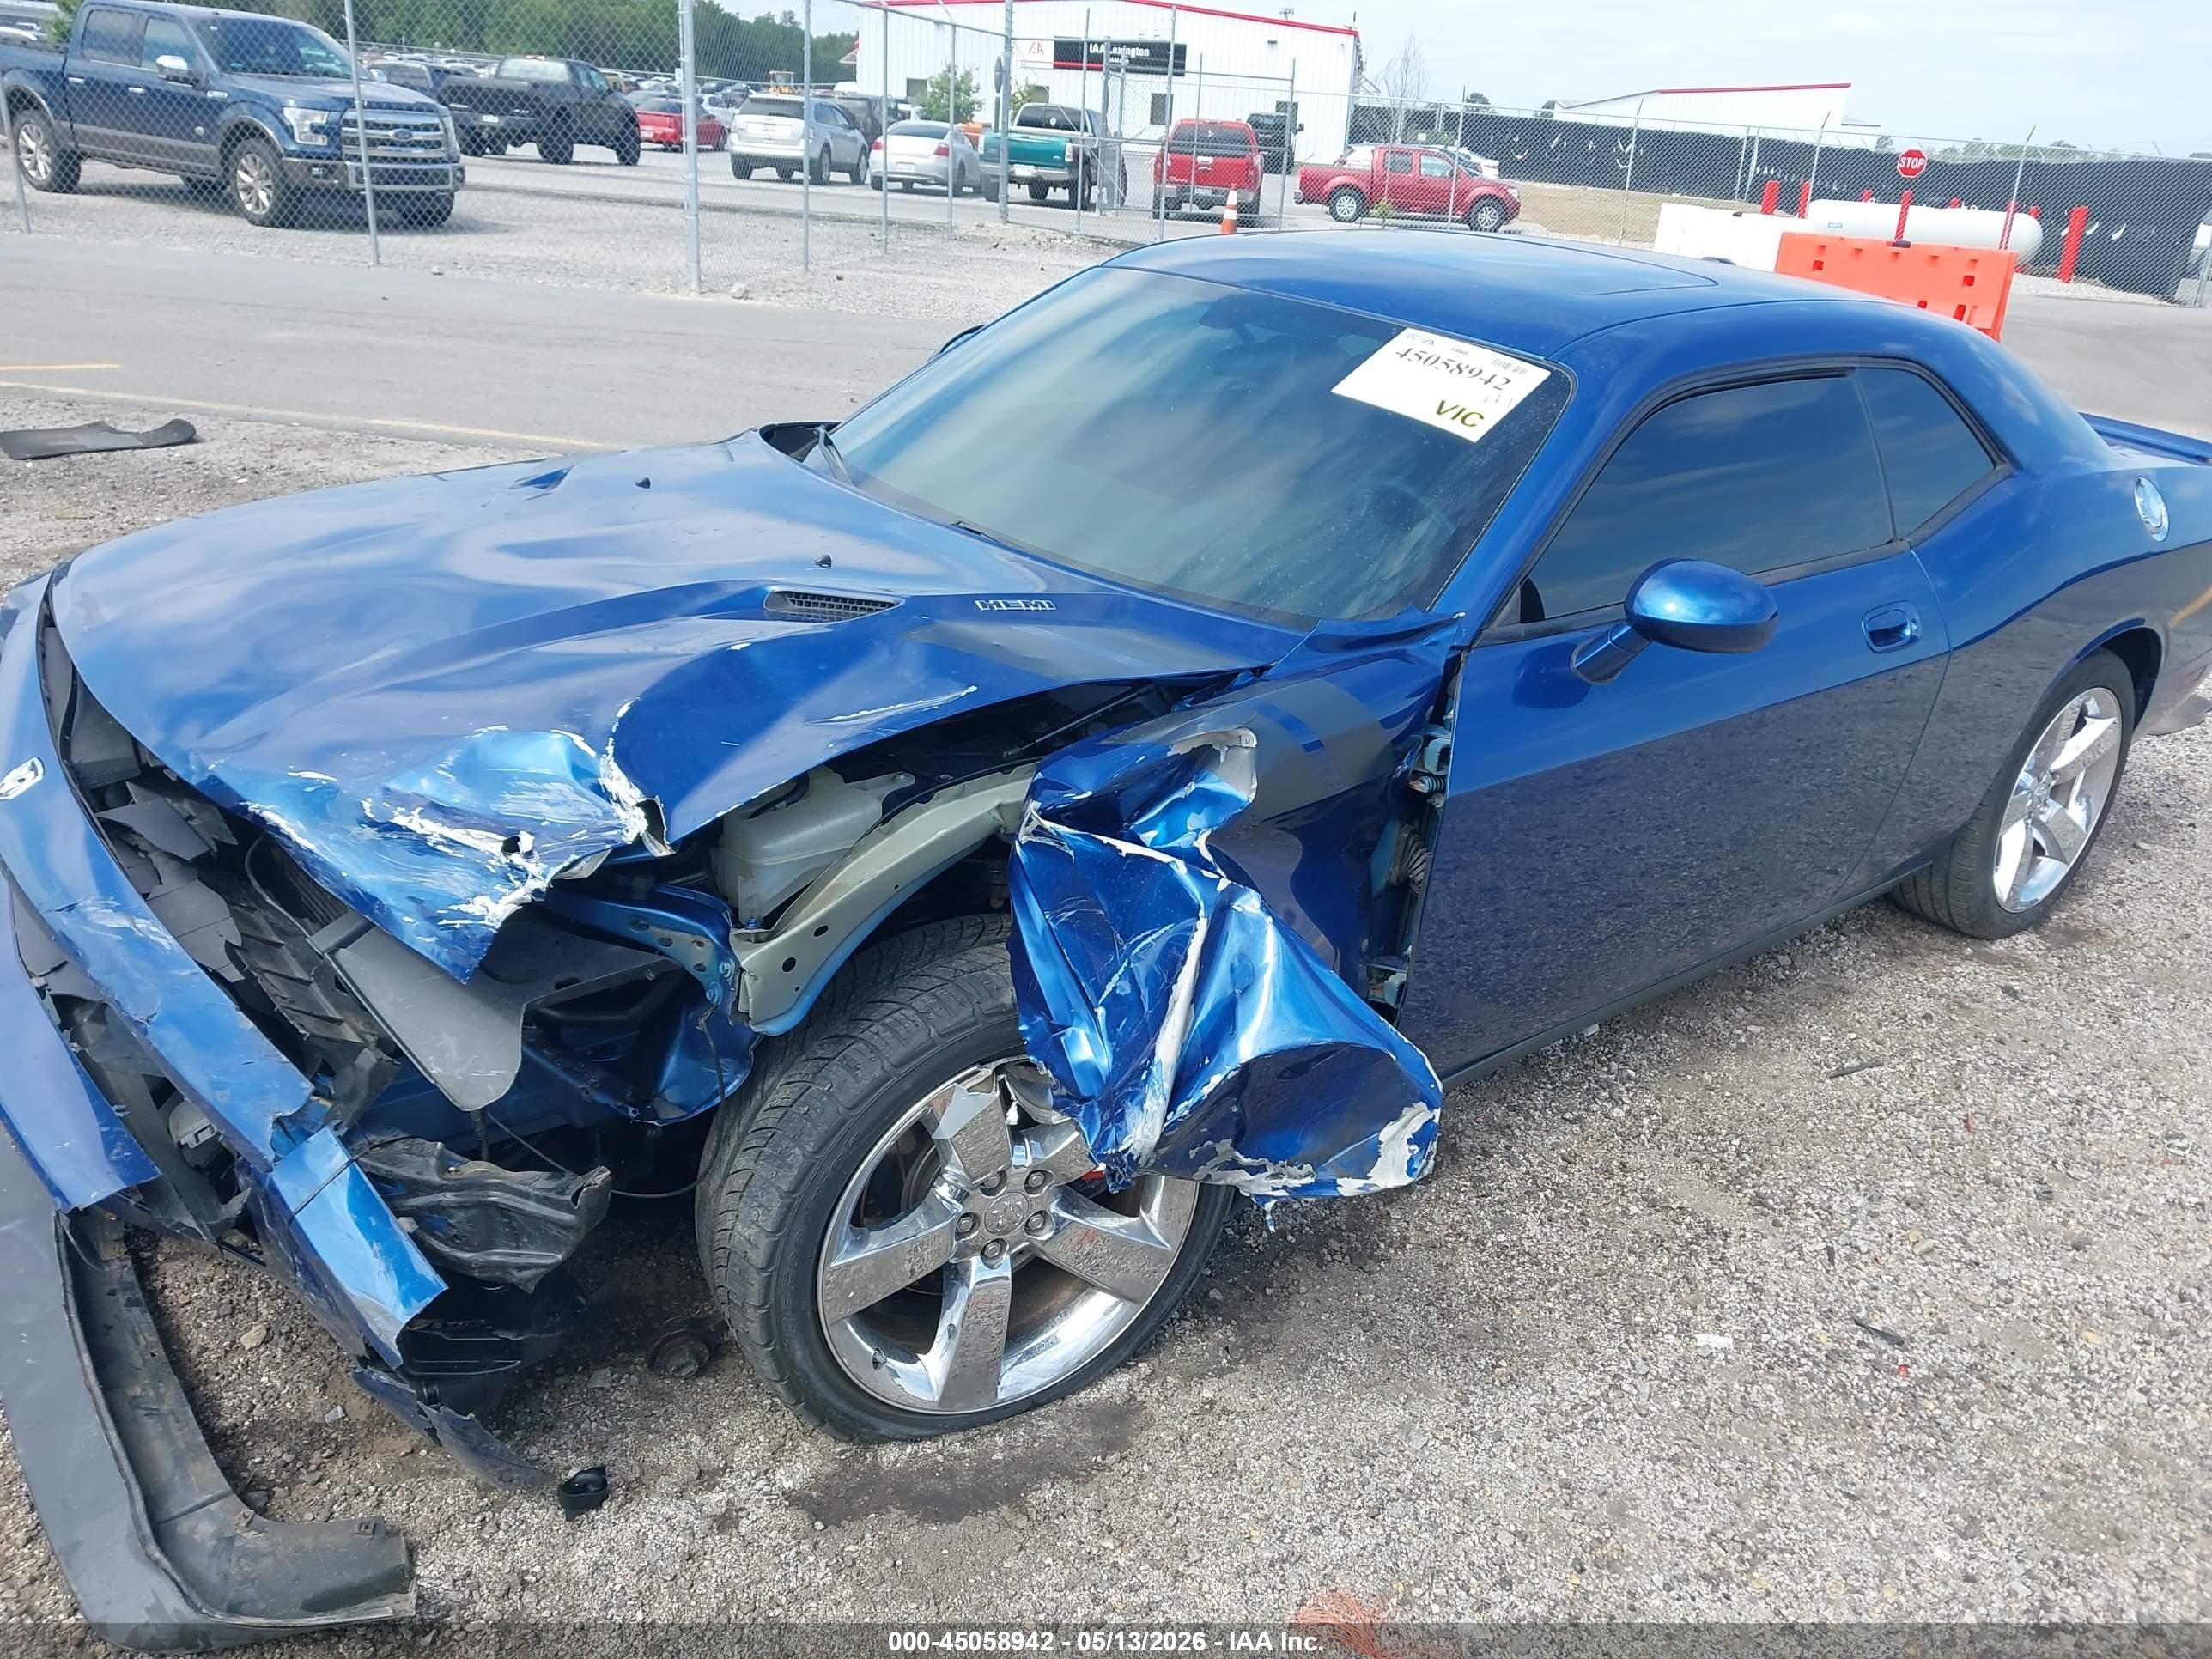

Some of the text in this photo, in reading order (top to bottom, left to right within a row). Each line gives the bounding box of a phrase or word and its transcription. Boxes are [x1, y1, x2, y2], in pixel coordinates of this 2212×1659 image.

[1089, 43, 1150, 58] IAA exington
[1899, 156, 1925, 169] STOP
[1395, 347, 1511, 391] 45058942
[1435, 399, 1485, 428] VIC
[975, 599, 1057, 611] HEMI
